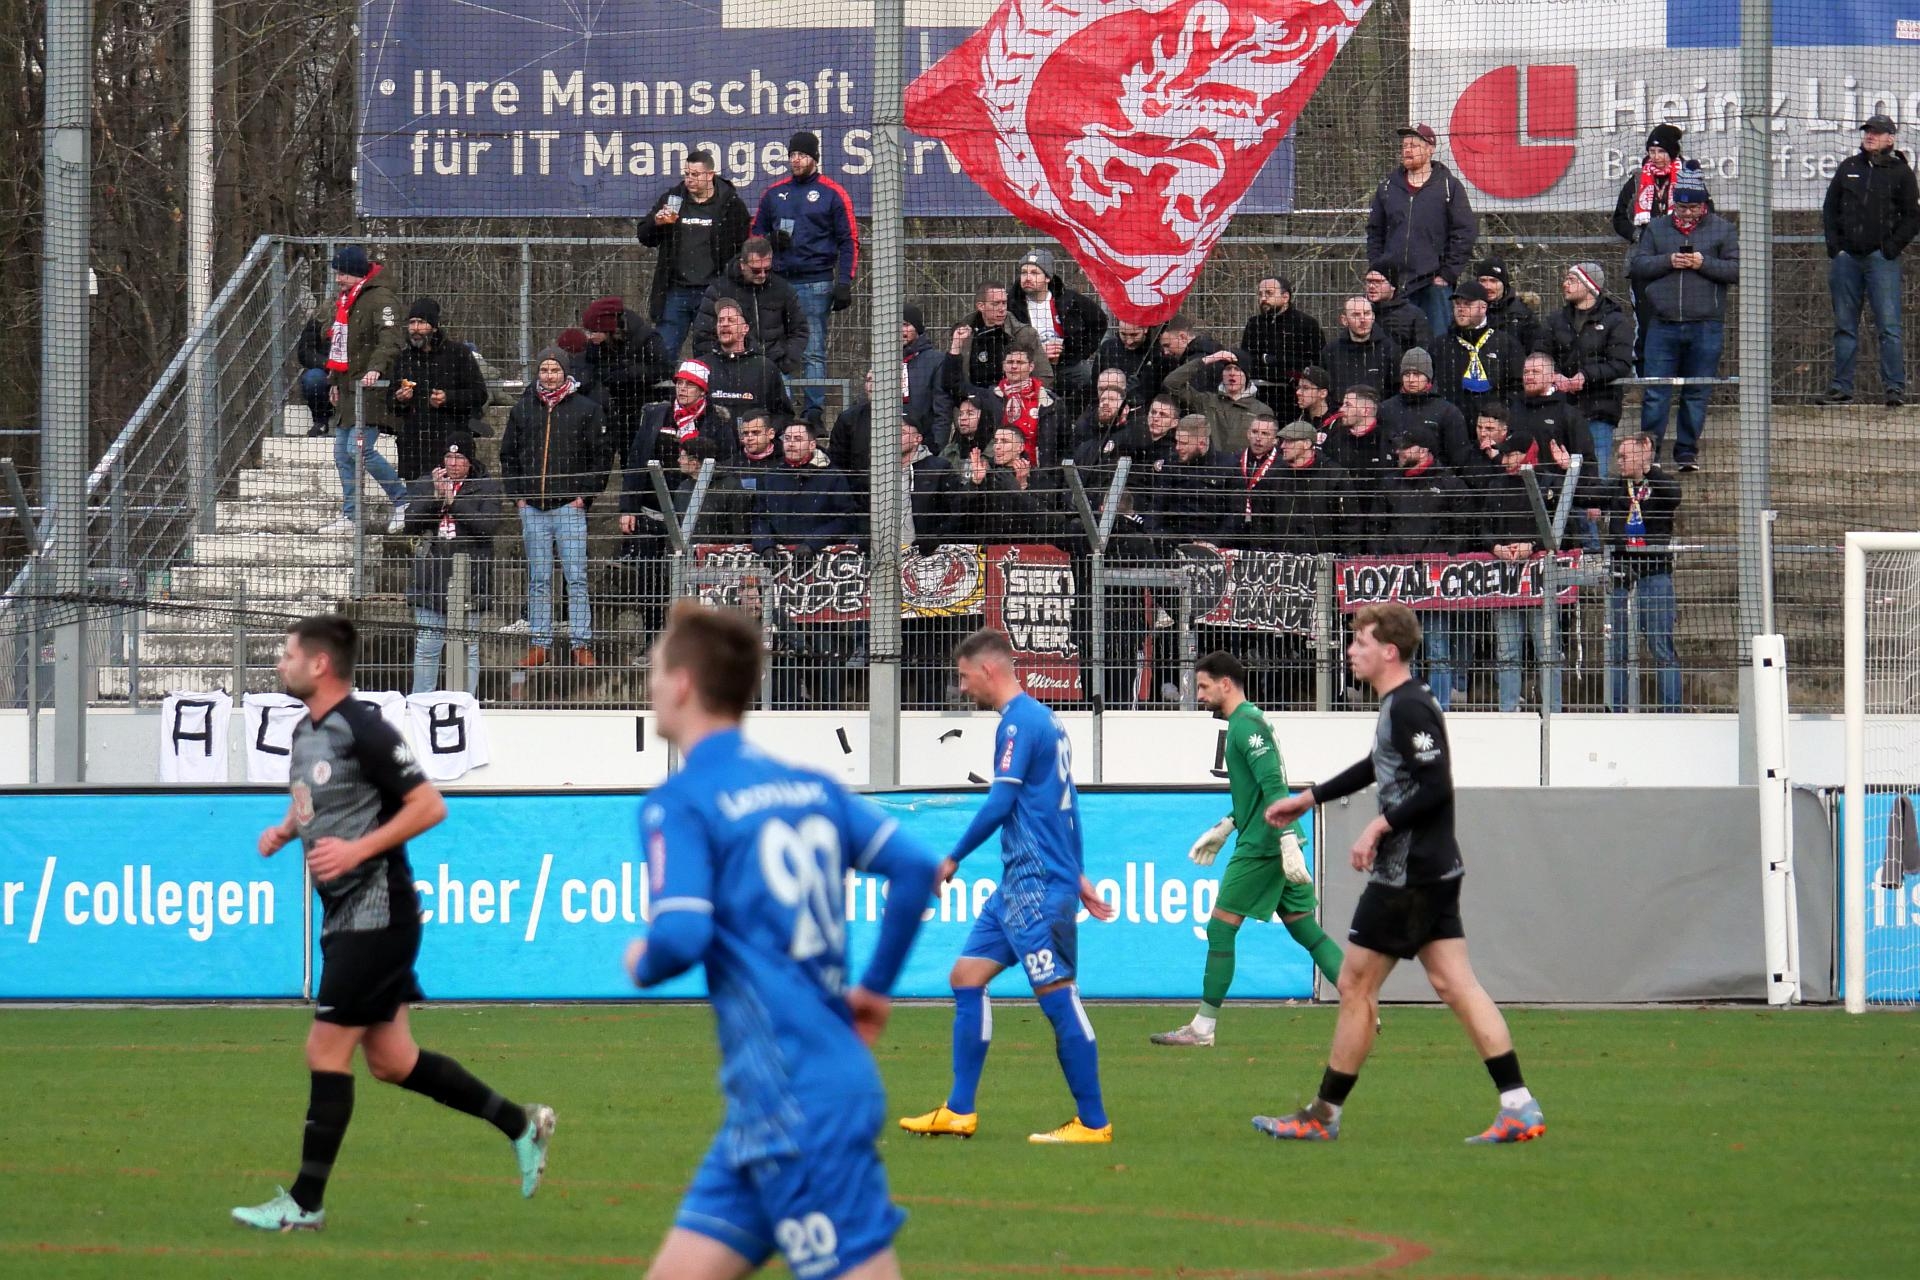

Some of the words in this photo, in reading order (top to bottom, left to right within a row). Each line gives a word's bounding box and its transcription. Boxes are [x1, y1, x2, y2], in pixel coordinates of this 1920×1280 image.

[414, 70, 519, 115] Ihre
[543, 69, 853, 115] Mannschaft
[411, 131, 491, 175] für
[512, 131, 559, 175] IT
[1345, 564, 1435, 604] LOYAL
[1440, 560, 1528, 600] CREW
[1026, 948, 1055, 976] 22
[774, 1211, 838, 1262] 20
